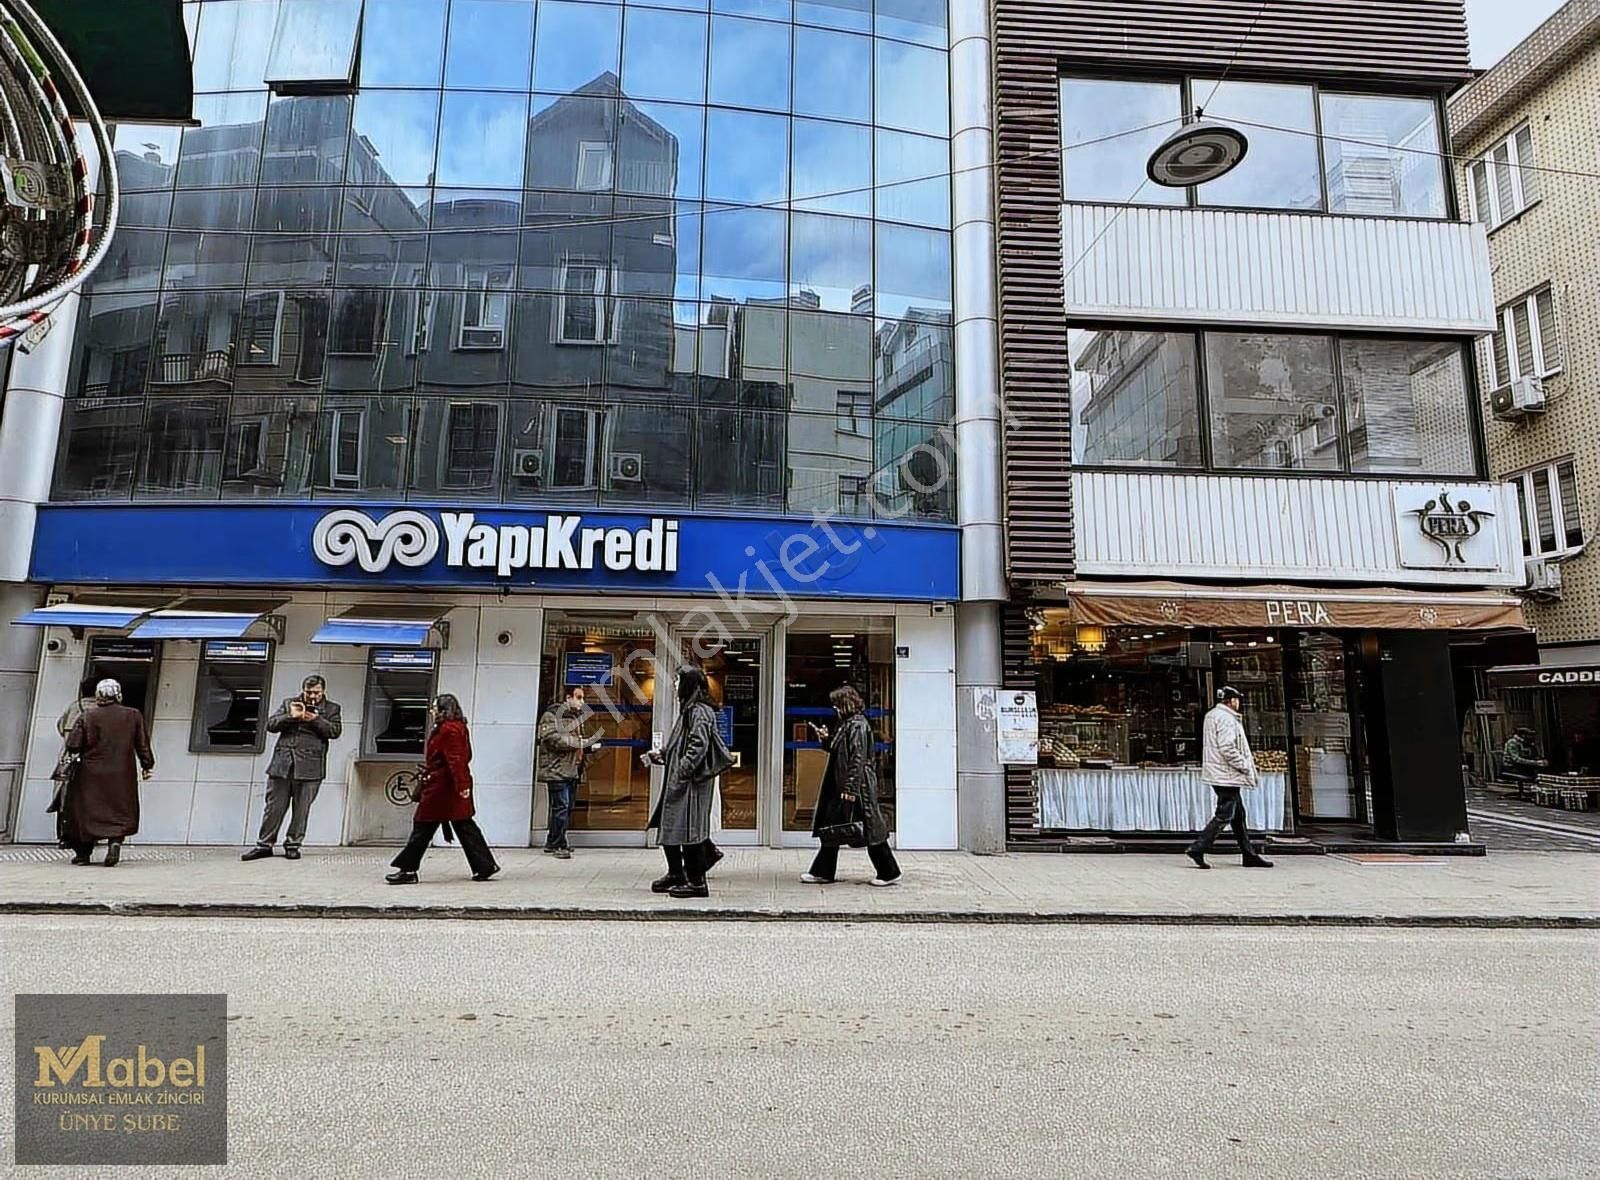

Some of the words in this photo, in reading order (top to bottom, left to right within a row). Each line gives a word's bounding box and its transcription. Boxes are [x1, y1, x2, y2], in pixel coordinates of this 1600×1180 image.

[1429, 518, 1469, 534] PERA
[441, 512, 679, 576] YapıKredi
[1267, 601, 1330, 625] PERA
